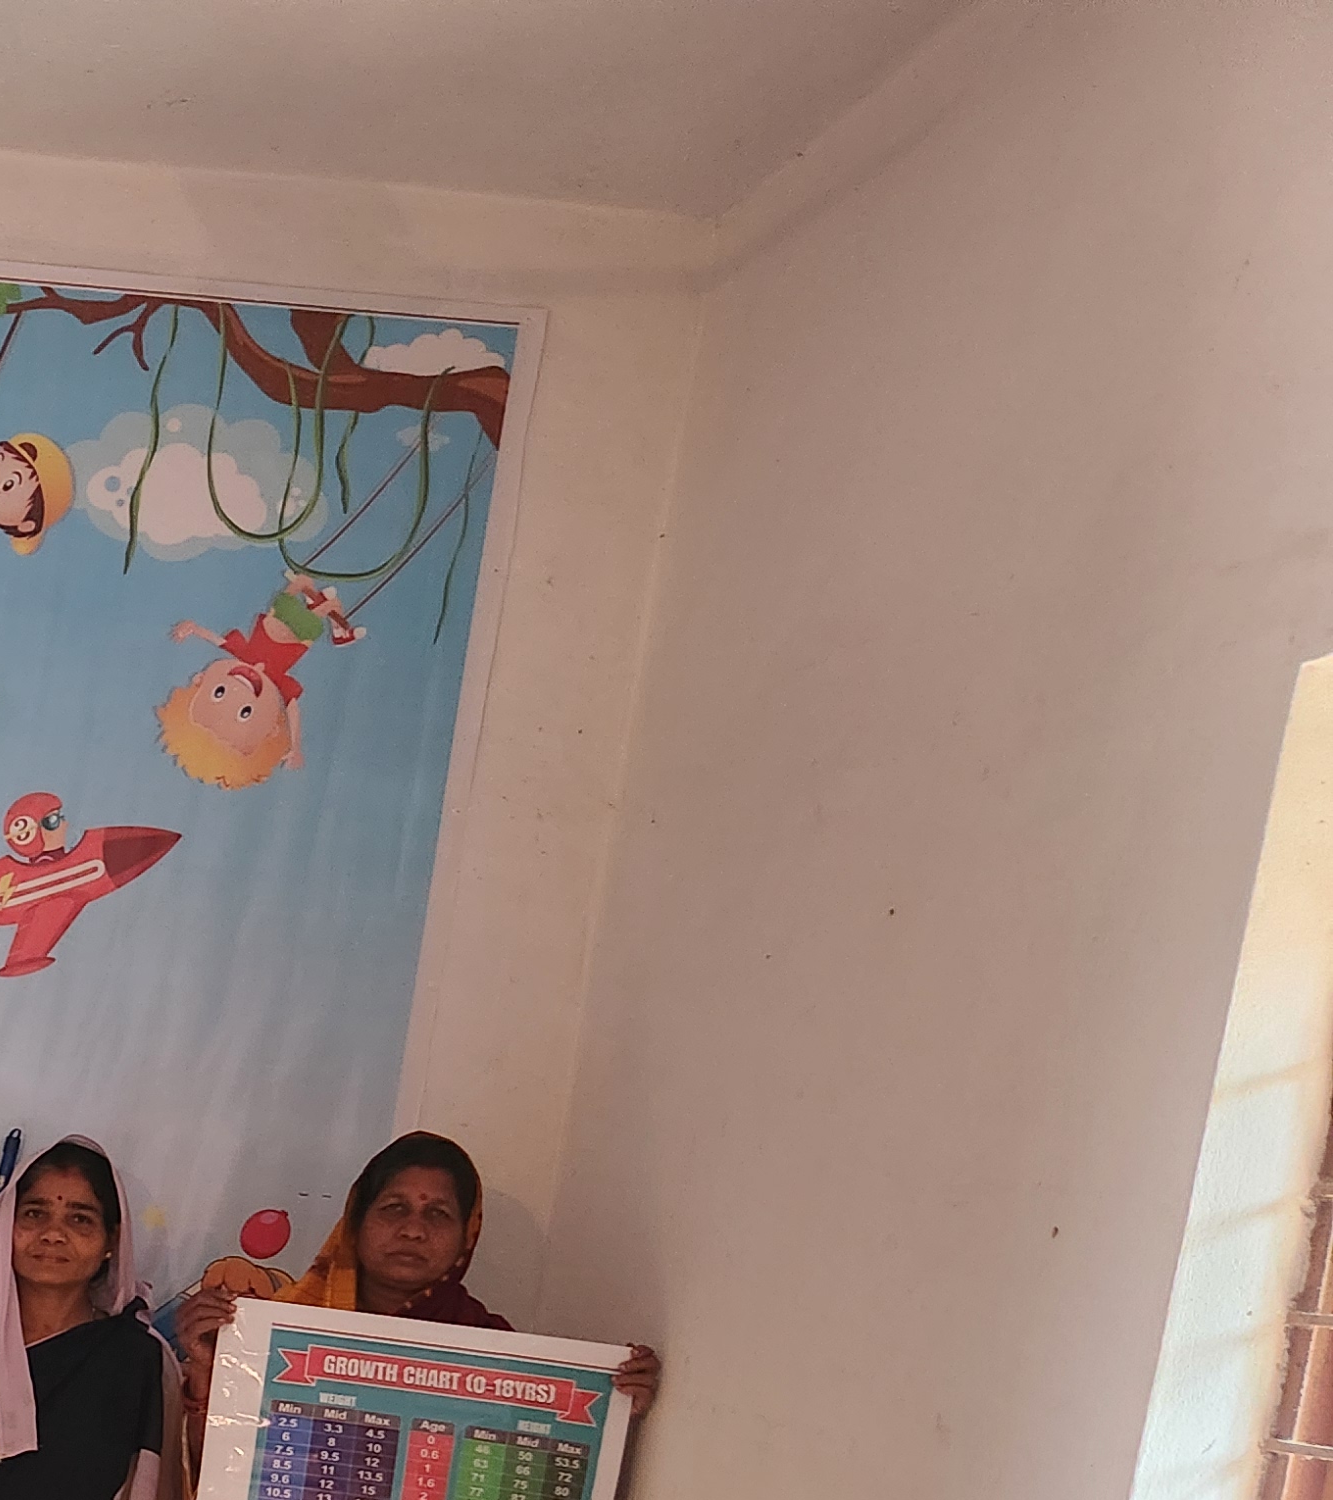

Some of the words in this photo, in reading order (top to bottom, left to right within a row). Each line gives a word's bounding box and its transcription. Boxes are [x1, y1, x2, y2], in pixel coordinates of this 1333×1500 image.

[14, 818, 30, 841] 3
[323, 1355, 397, 1382] GROWTH
[404, 1365, 459, 1390] CHART
[278, 1417, 298, 1428] 2.5
[323, 1423, 343, 1434] 3.3
[365, 1429, 385, 1439] 4.5
[426, 1434, 435, 1444] 0
[279, 1402, 302, 1415] Min
[324, 1408, 347, 1421] Mid
[364, 1413, 391, 1427] Max
[420, 1420, 446, 1434] Age
[473, 1428, 497, 1441] Min
[517, 1436, 540, 1447] Mid
[557, 1442, 582, 1455] Max
[274, 1444, 294, 1456] 7.5
[319, 1450, 340, 1461] 9.5
[364, 1457, 380, 1468] 12
[424, 1463, 431, 1473] 1
[281, 1431, 290, 1441] 6
[327, 1437, 336, 1446] 8
[366, 1442, 382, 1453] 10
[420, 1448, 439, 1459] 0.6
[270, 1473, 290, 1484] 9.6
[319, 1479, 334, 1489] 12
[361, 1485, 376, 1495] 15
[418, 1491, 428, 1500] 2
[272, 1459, 292, 1470] 8.5
[321, 1464, 334, 1475] 11
[357, 1470, 383, 1482] 13.5
[417, 1476, 435, 1488] 1.6
[266, 1486, 292, 1498] 10.5
